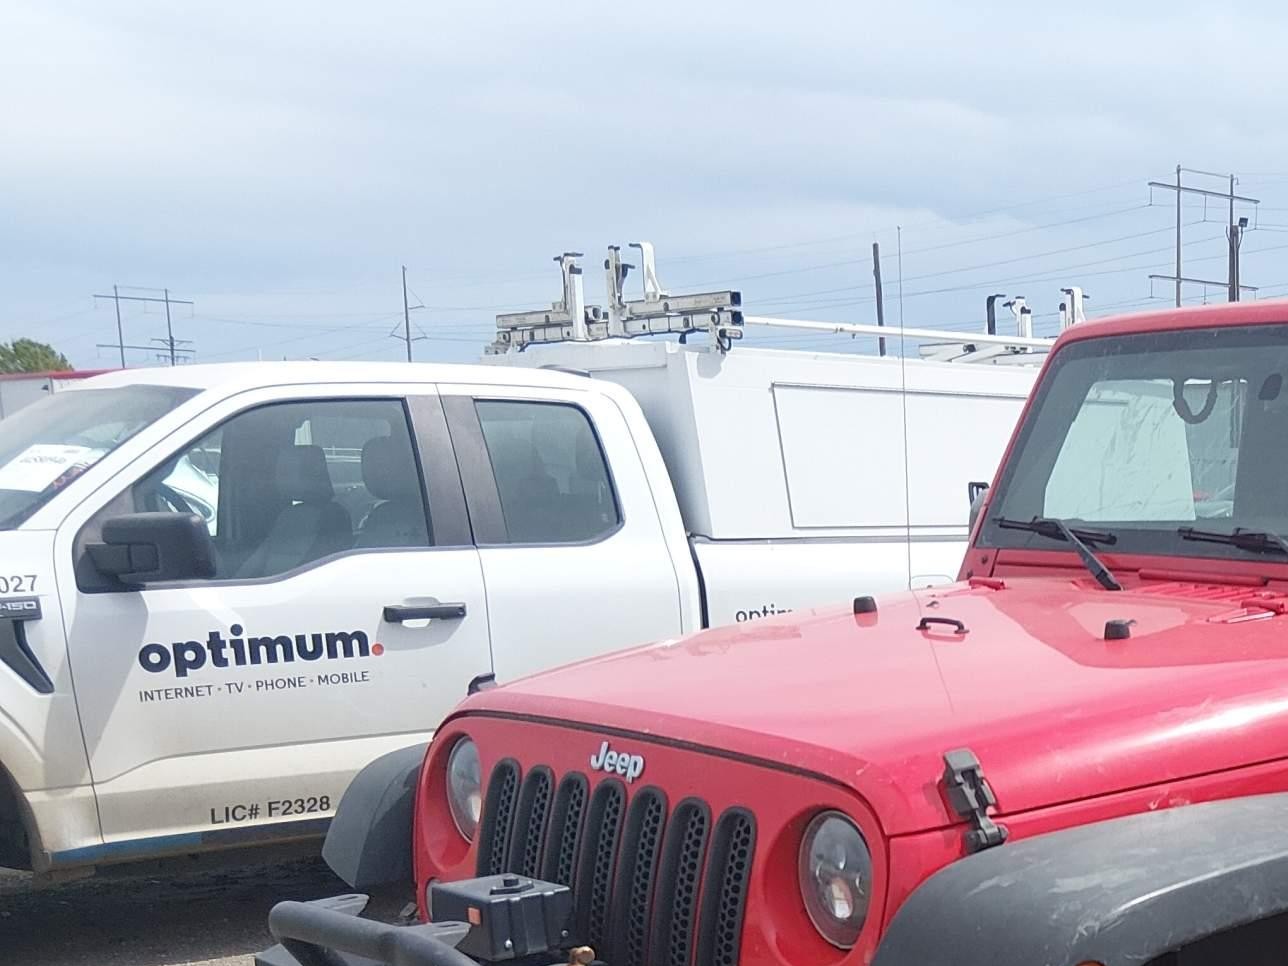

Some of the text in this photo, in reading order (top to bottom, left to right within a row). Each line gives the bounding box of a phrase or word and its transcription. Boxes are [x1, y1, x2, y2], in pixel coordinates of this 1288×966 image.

[139, 670, 370, 703] INTERNET TV PHONE MOBILE
[590, 741, 644, 783] Jeep
[210, 795, 331, 824] LIC# F2328
